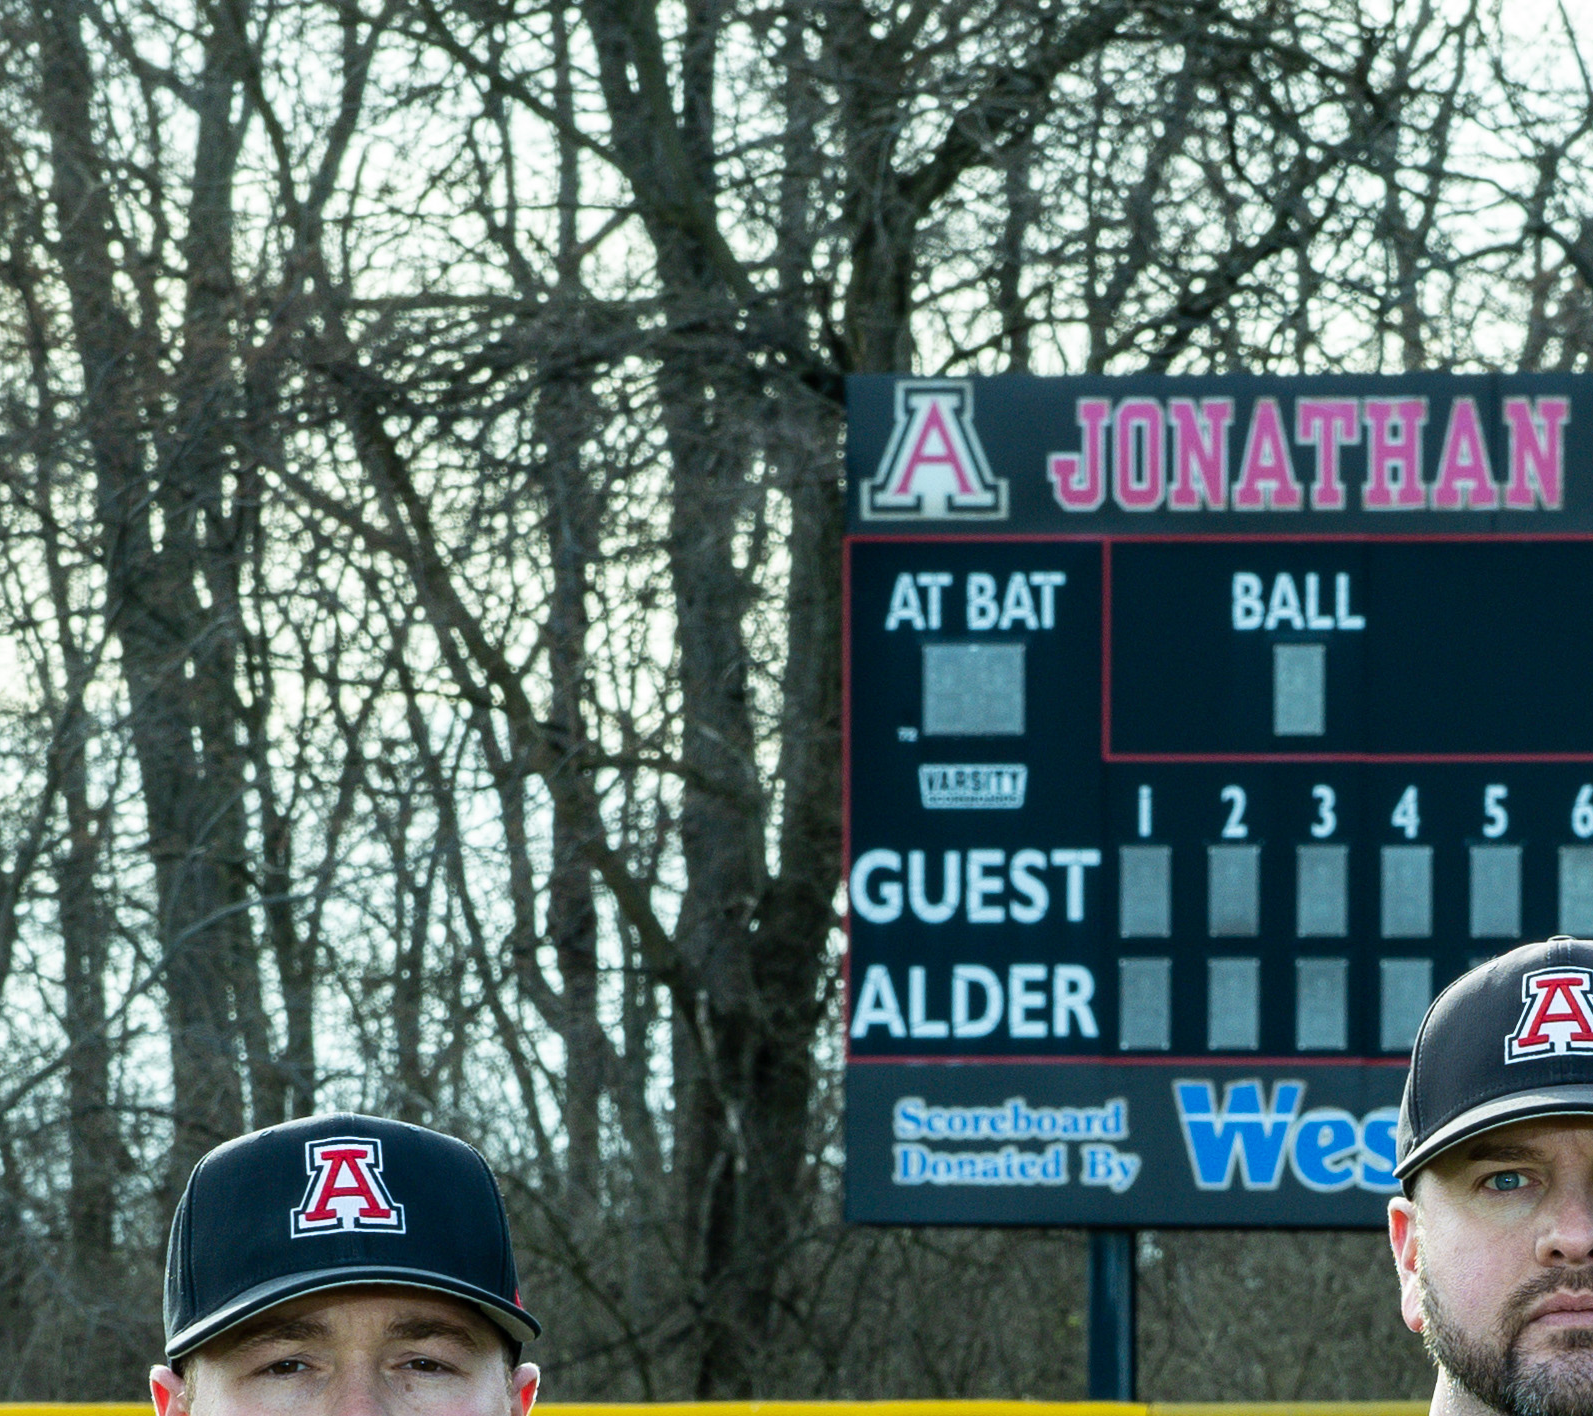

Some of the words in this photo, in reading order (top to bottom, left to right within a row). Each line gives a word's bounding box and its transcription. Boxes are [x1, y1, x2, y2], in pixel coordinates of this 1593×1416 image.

[860, 380, 1009, 520] A
[1047, 396, 1571, 512] JONATHAN
[884, 571, 954, 632] AT
[966, 571, 1067, 632] BAT
[1231, 571, 1366, 631] BALL
[1137, 784, 1153, 838] 1
[1220, 784, 1249, 839] 2
[1310, 784, 1338, 839] 3
[1390, 785, 1421, 840] 4
[1482, 784, 1509, 839] 5
[849, 848, 1102, 925] GUEST
[849, 963, 1100, 1039] ALDER
[892, 1096, 1131, 1141] Scoreboard
[1171, 1077, 1405, 1193] Wes
[290, 1135, 407, 1239] A
[891, 1142, 1071, 1187] Donated
[1078, 1142, 1143, 1194] By
